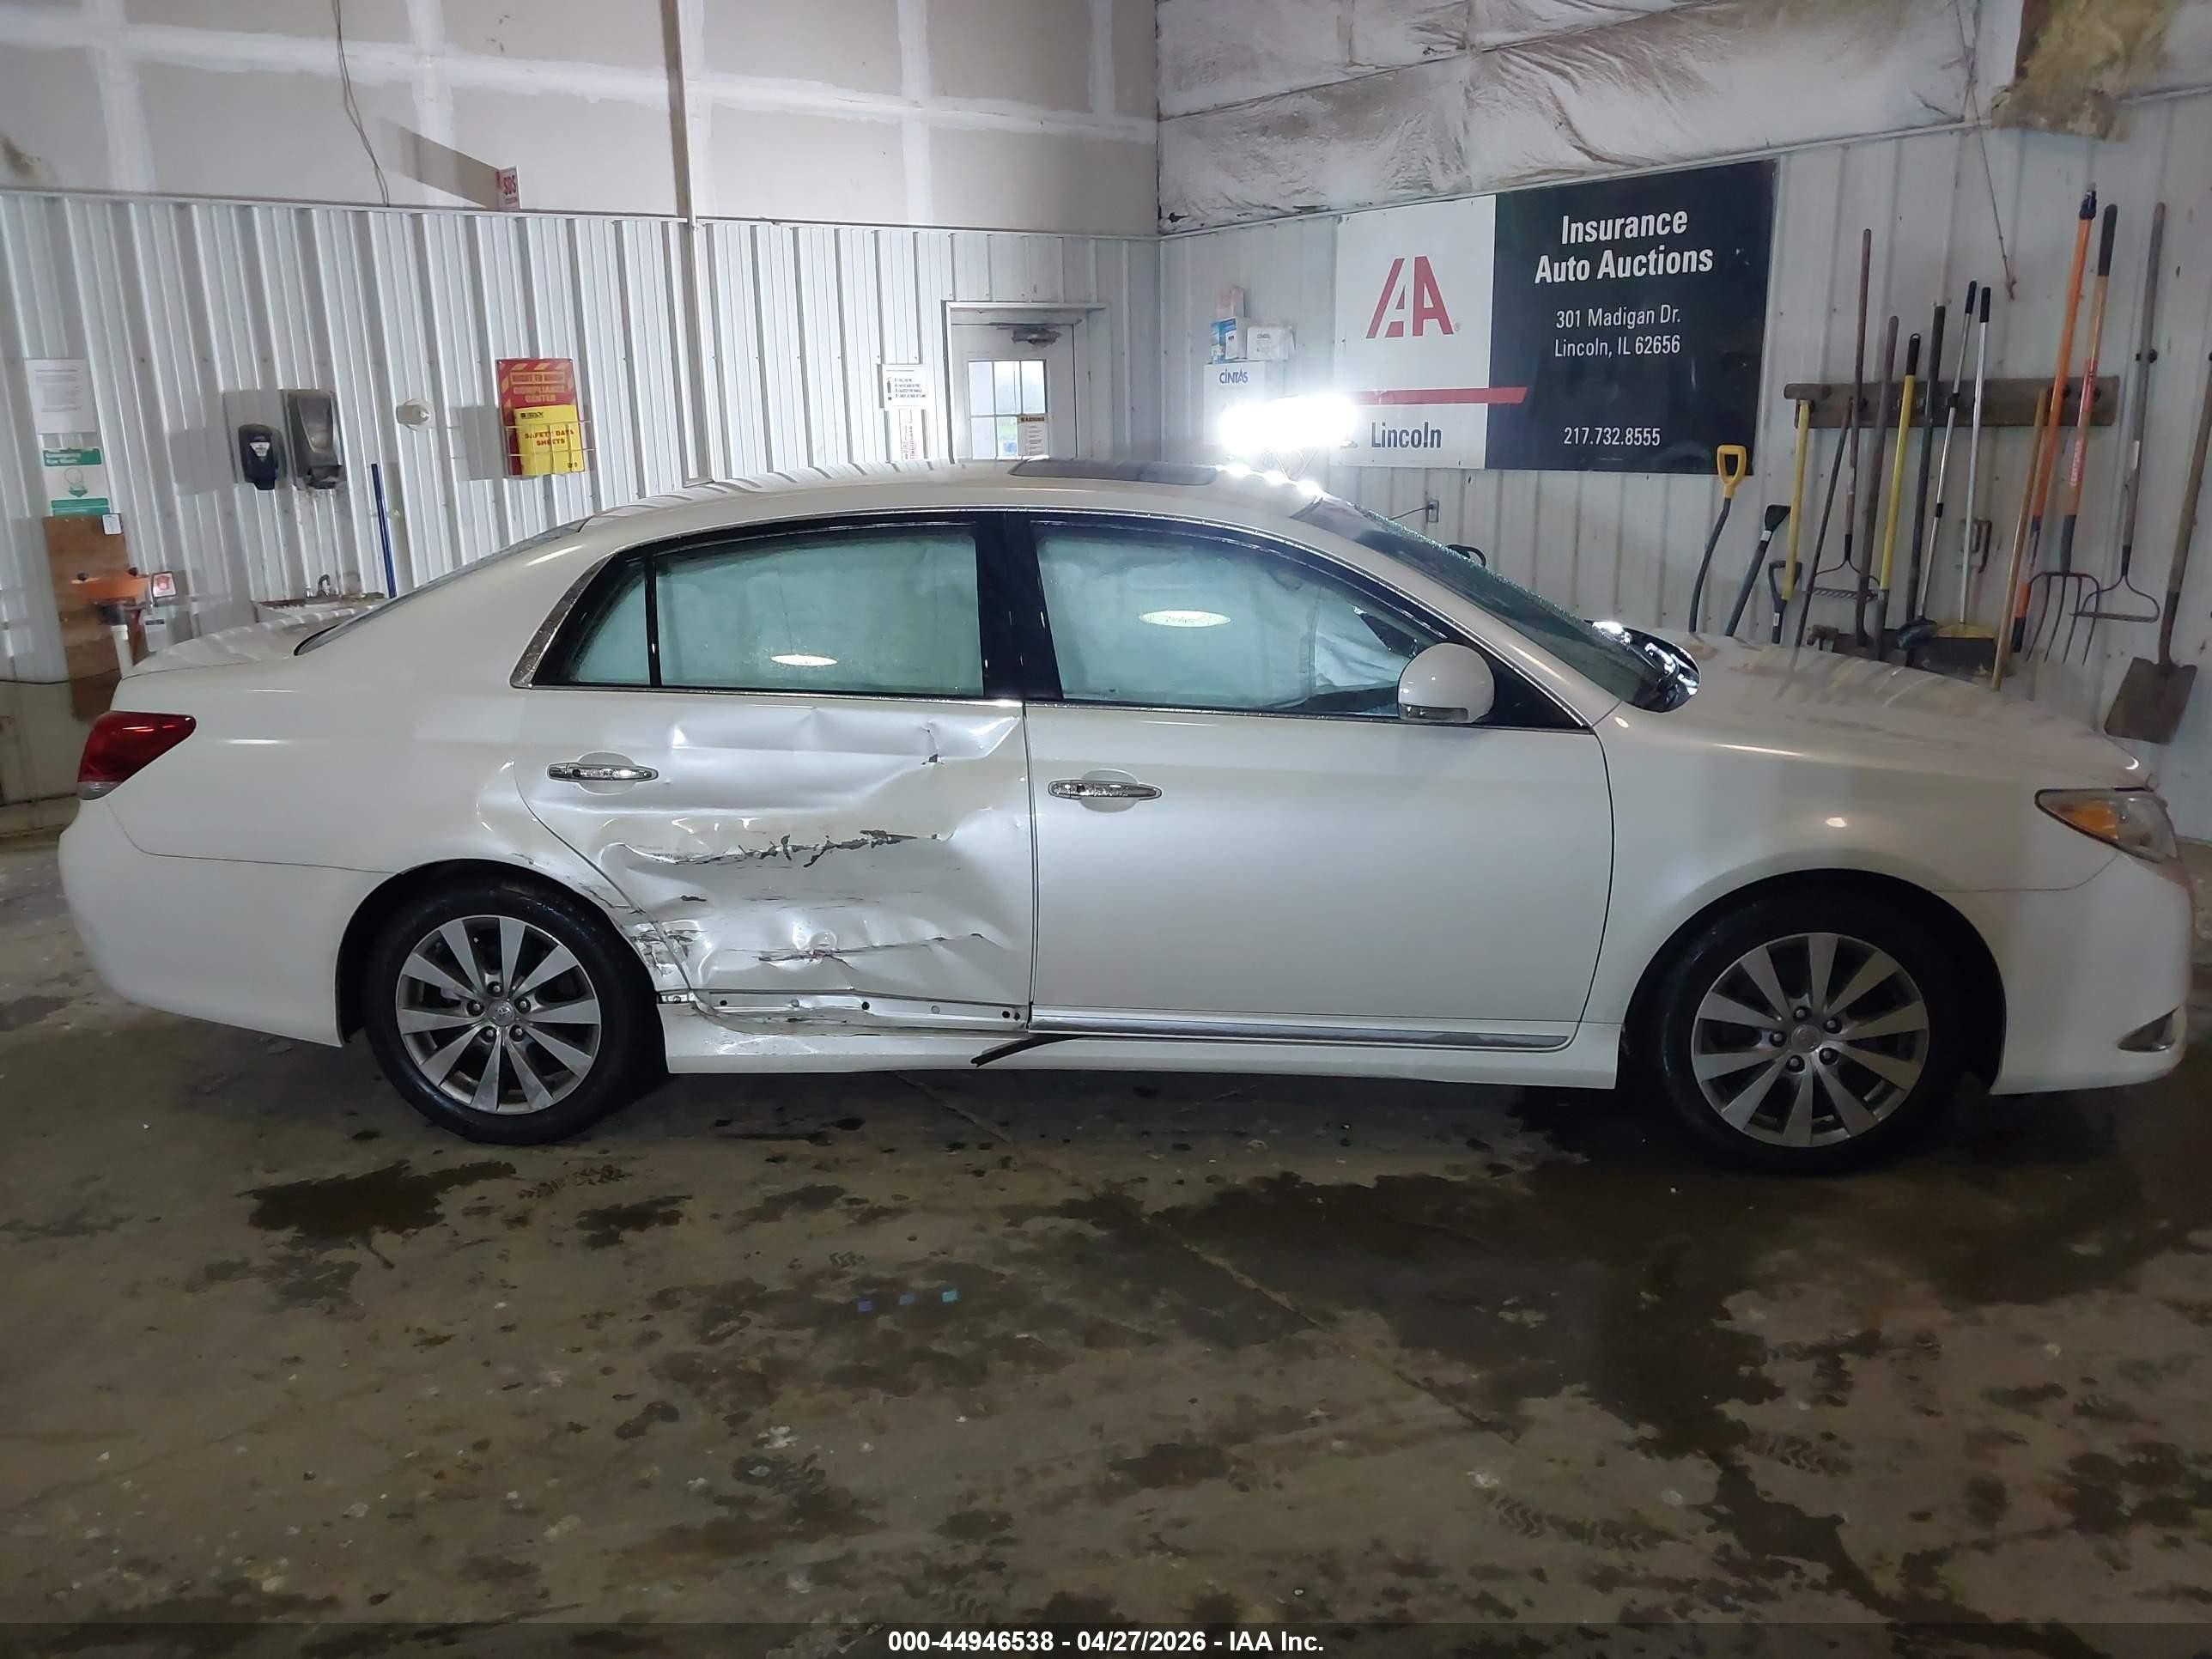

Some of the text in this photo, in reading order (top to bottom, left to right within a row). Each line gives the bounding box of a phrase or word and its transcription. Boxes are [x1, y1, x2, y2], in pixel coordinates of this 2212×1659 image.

[1561, 210, 1688, 245] Insurance
[1534, 245, 1714, 284] Auto Auctions
[1556, 304, 1681, 330] 301 Madigan Dr.
[1554, 334, 1680, 359] Lincoln, IL 62656
[1218, 368, 1249, 385] CINTAS
[1371, 422, 1442, 448] Lincoln
[1563, 427, 1661, 446] 217.732.8555
